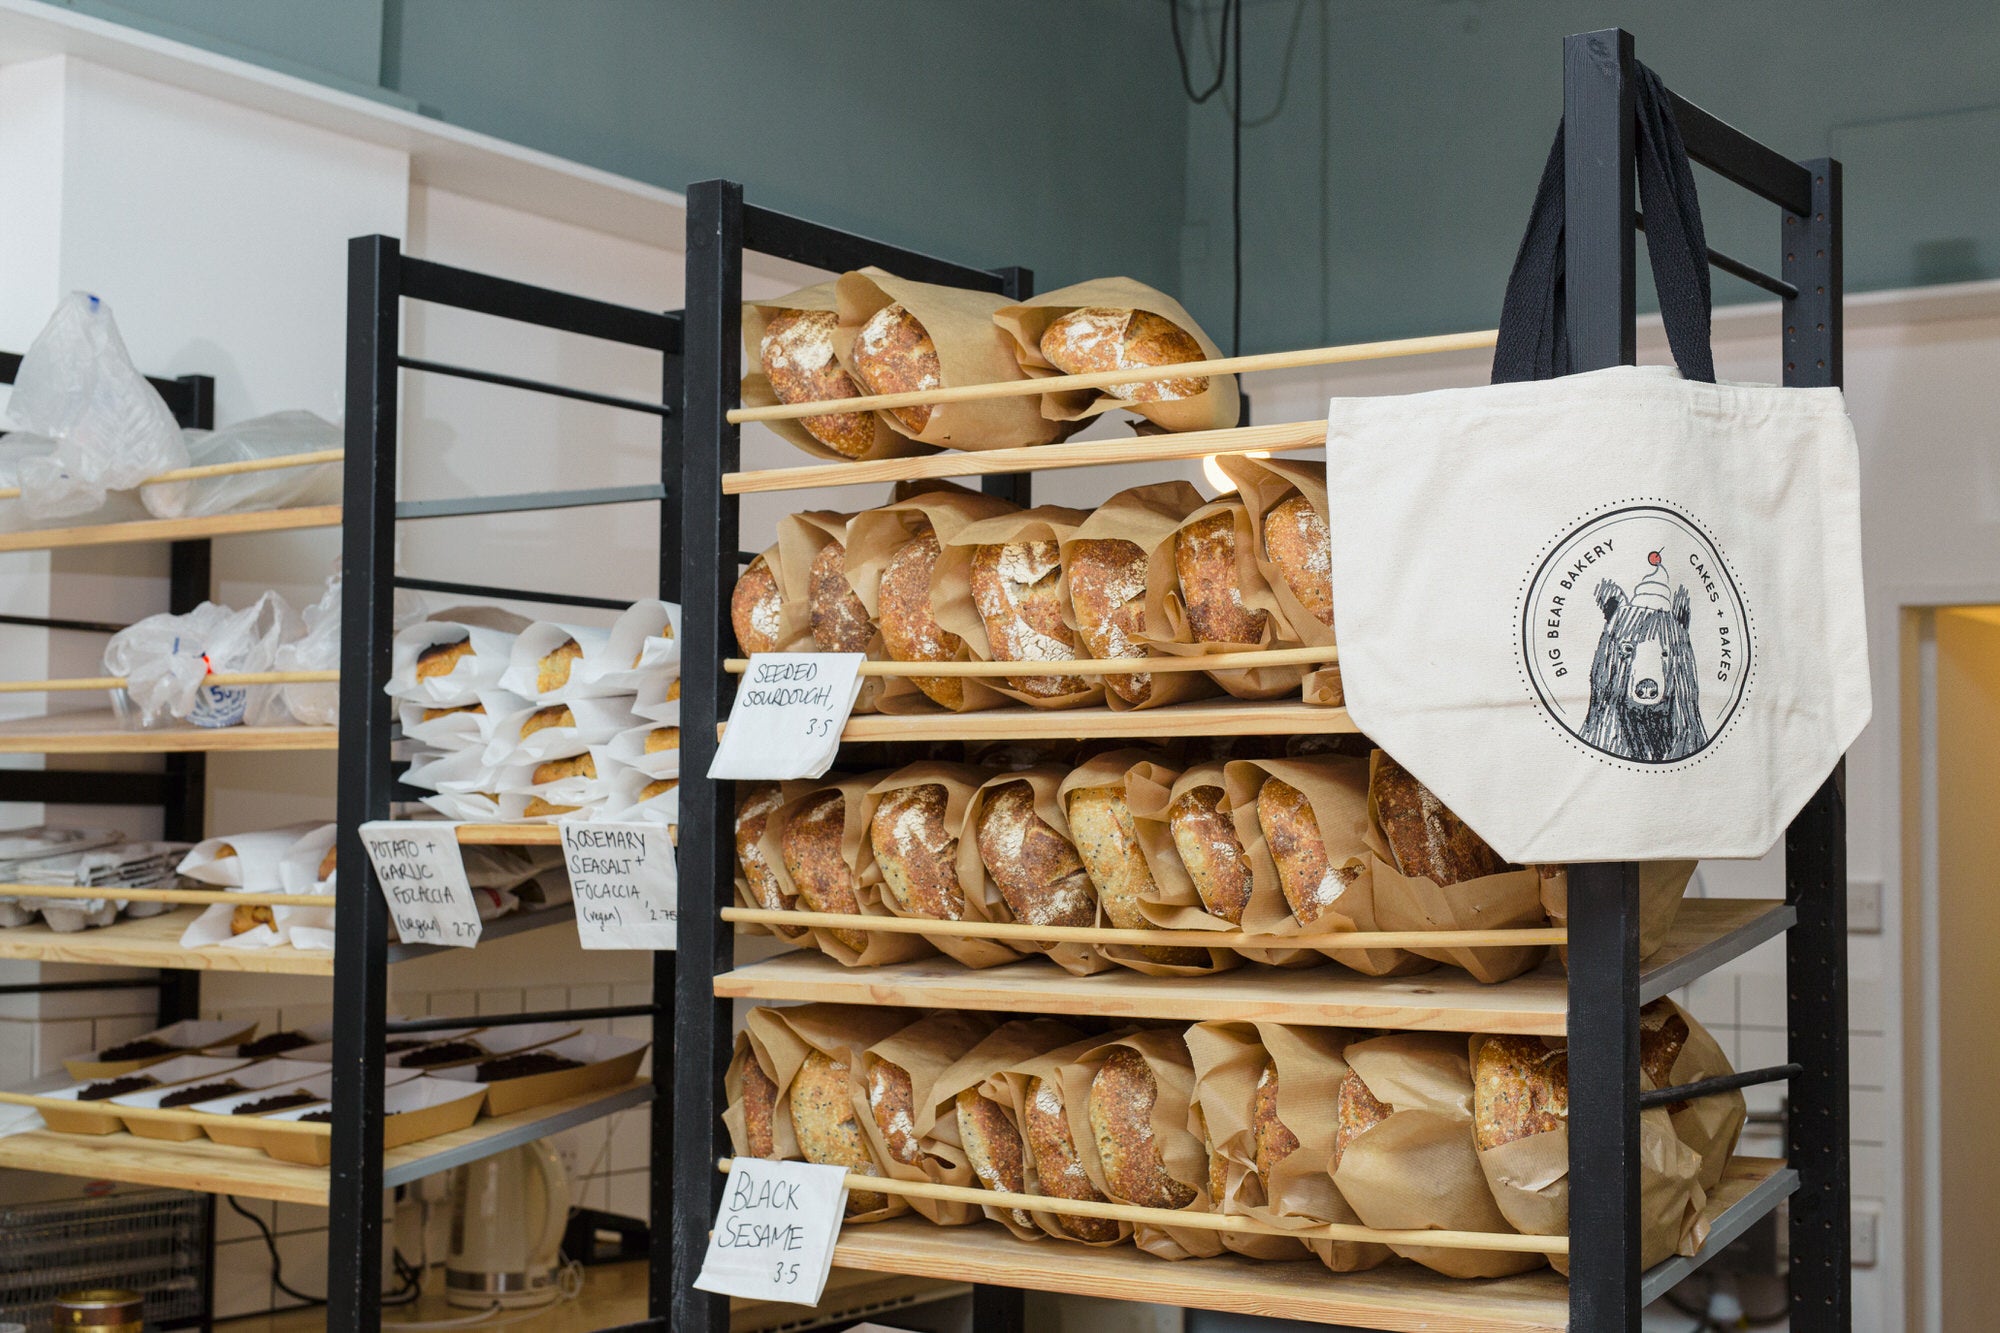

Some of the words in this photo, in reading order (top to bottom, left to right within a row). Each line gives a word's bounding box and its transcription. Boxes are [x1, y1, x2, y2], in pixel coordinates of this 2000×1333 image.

[1559, 538, 1614, 590] BAKERY
[1547, 595, 1566, 639] BEAR
[1689, 553, 1720, 603] CAKES
[1717, 626, 1732, 683] BAKES
[753, 662, 818, 684] SEEDED
[1548, 648, 1568, 678] BIG
[370, 840, 419, 860] POTATO
[566, 825, 646, 857] ROSEMARY
[380, 862, 434, 881] GARLIC
[570, 854, 631, 875] SEASALT
[392, 885, 455, 904] FOCACCIA
[729, 1171, 800, 1212] BLACK
[718, 1215, 804, 1251] SESAME
